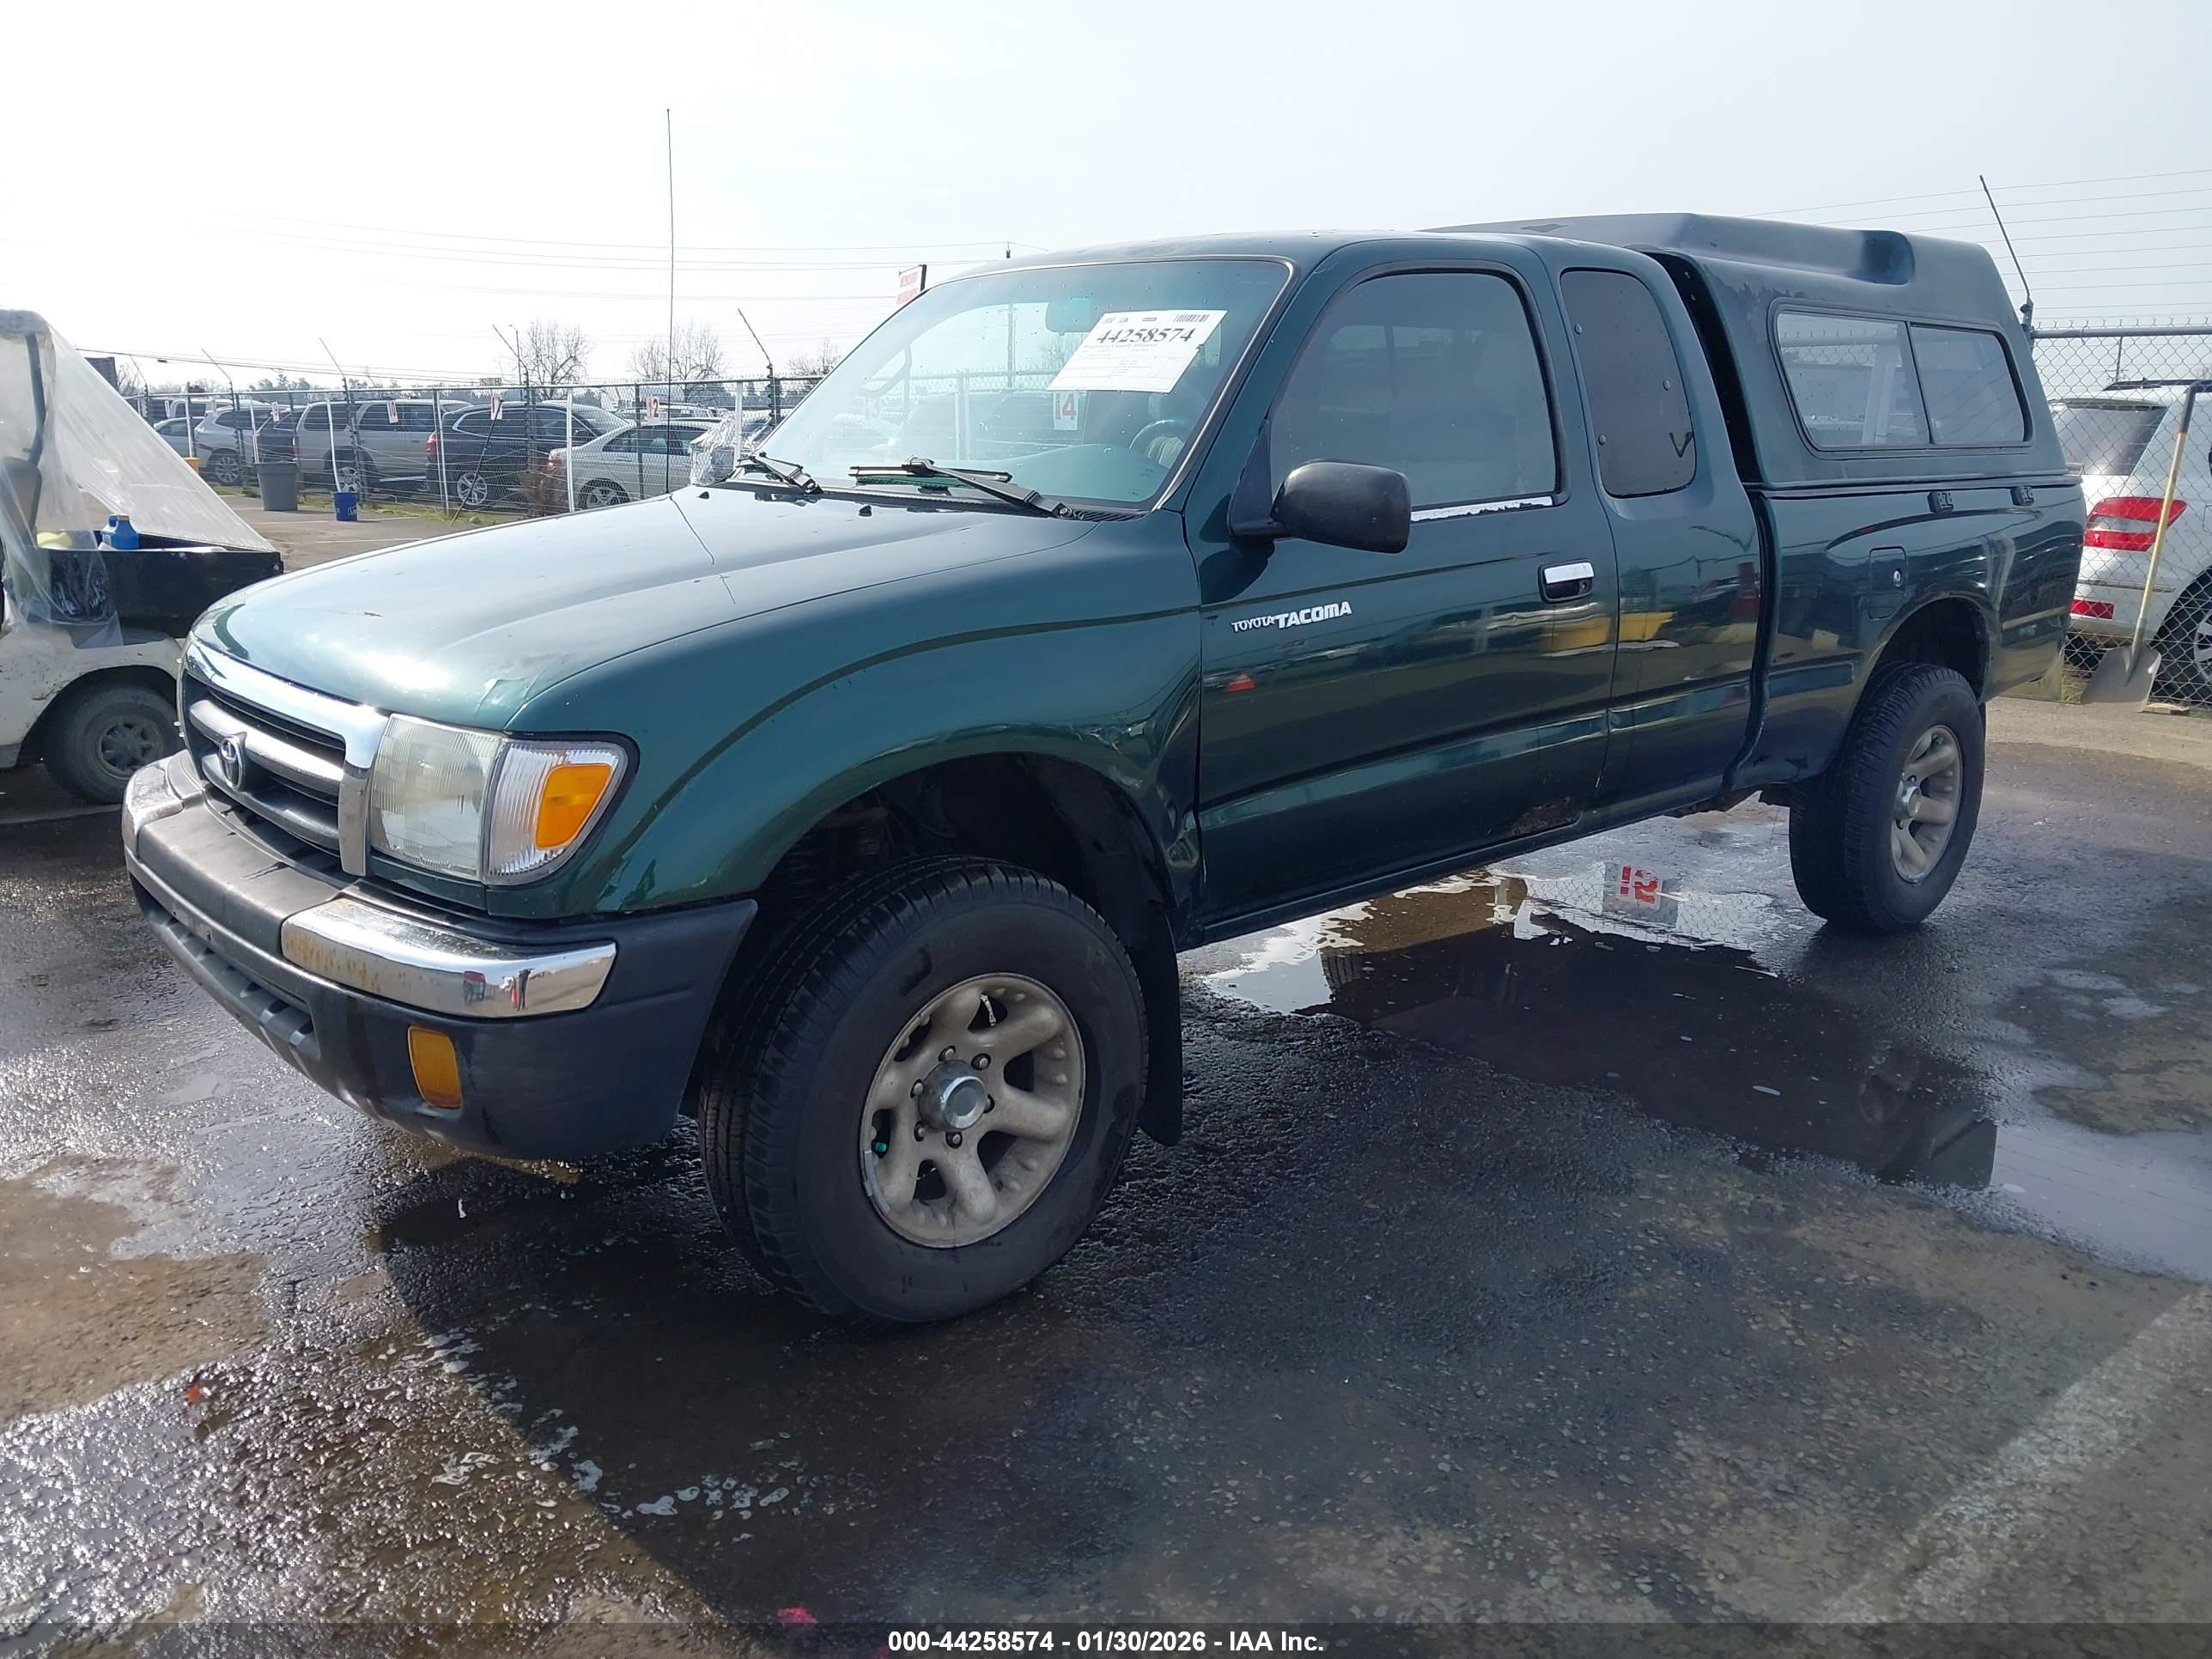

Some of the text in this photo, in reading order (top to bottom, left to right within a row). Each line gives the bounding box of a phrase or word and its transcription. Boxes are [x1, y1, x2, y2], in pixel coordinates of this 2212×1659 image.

[1097, 328, 1196, 343] 44258574
[1055, 392, 1077, 419] 14
[1231, 600, 1352, 633] TOYOTA TACOMA
